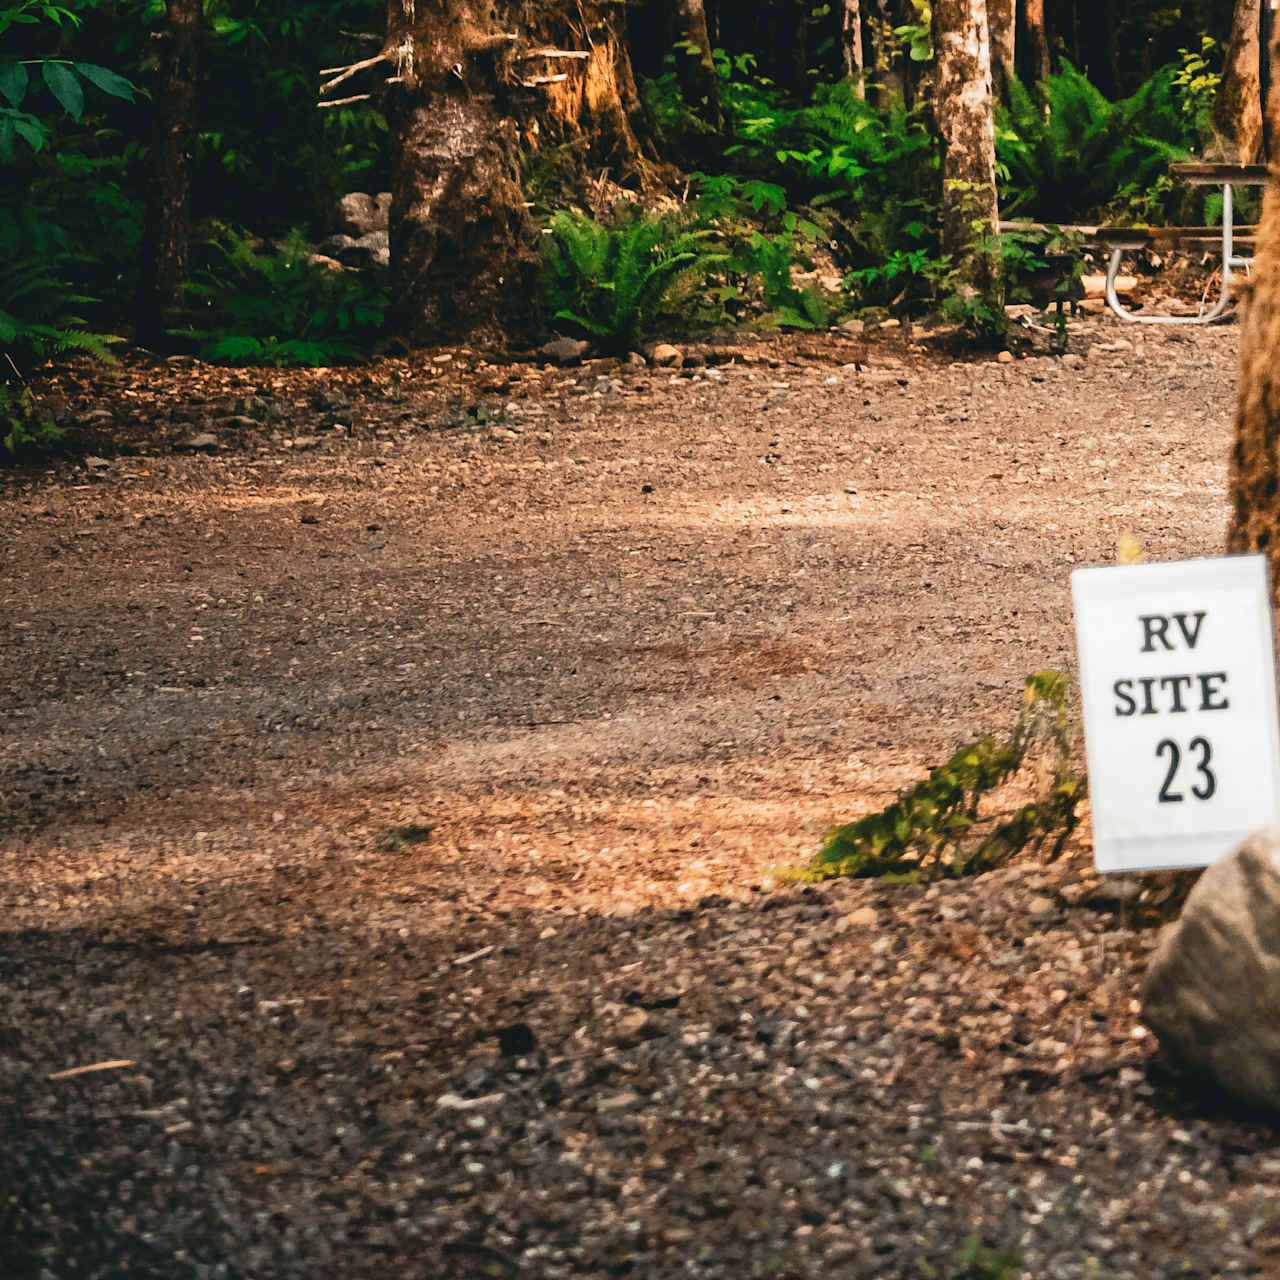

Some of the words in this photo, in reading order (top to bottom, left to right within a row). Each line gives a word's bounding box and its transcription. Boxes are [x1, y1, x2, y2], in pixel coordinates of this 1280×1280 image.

[1138, 611, 1207, 653] RV
[1112, 672, 1230, 717] SITE
[1155, 736, 1216, 804] 23
